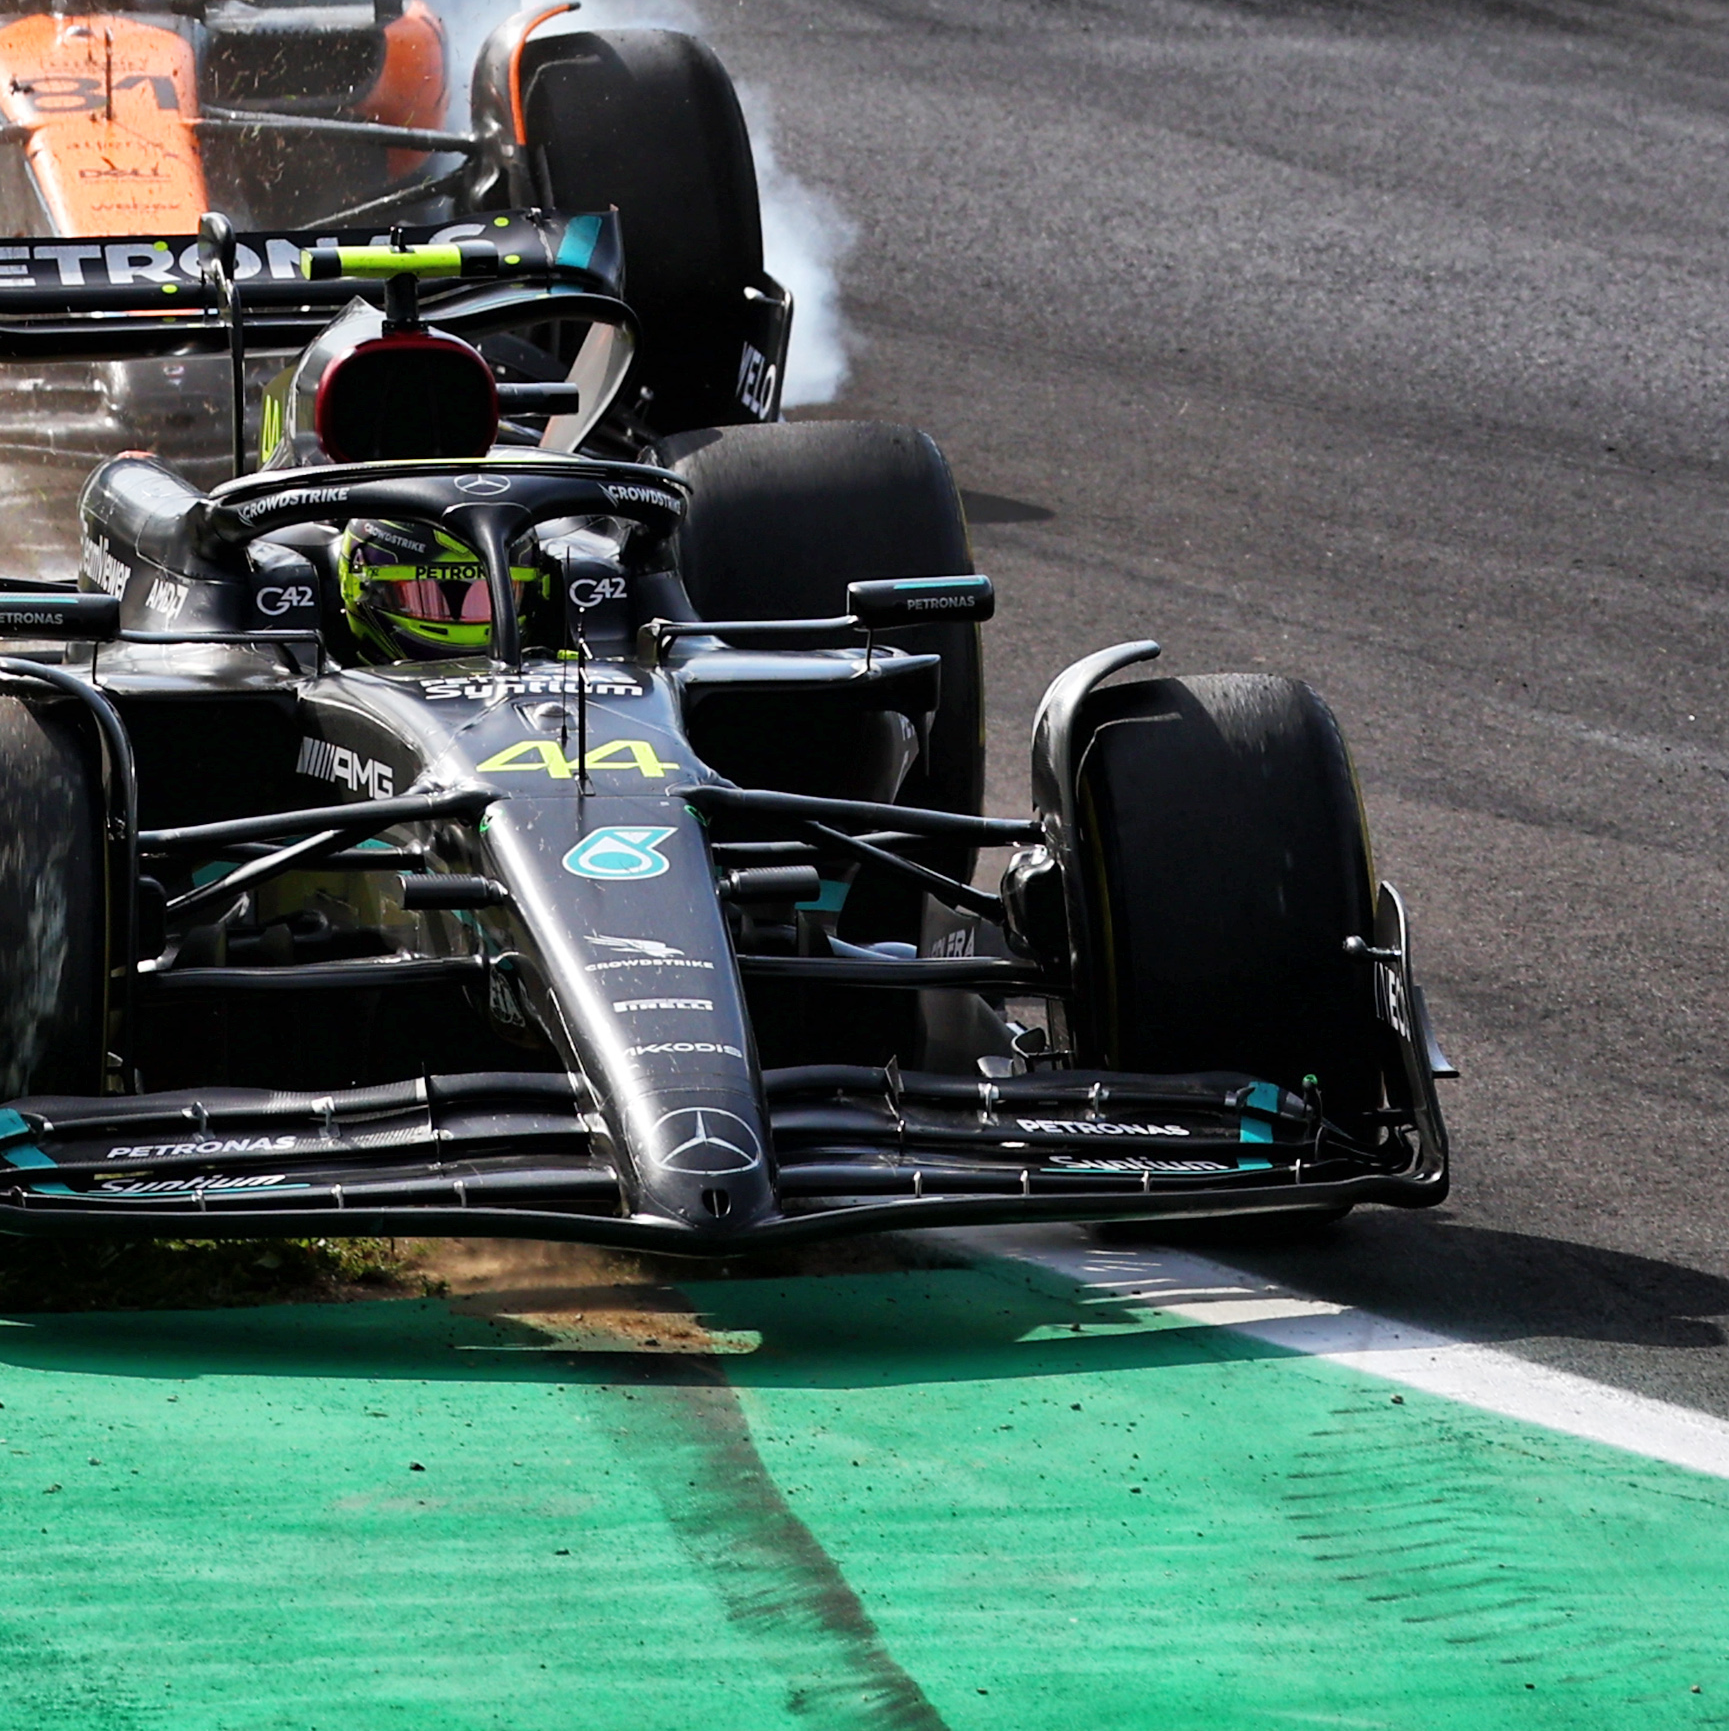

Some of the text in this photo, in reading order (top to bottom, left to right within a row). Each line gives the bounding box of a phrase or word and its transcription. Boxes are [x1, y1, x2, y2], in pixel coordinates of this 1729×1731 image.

[20, 75, 180, 113] 81
[242, 486, 351, 520] CROWDSTRIKE
[607, 484, 682, 516] CROWDSTRIKE
[363, 522, 427, 554] CROWDSTRIKE
[145, 577, 181, 616] AMD
[256, 585, 315, 616] G42
[569, 577, 628, 608] G42
[907, 595, 976, 611] PETRONAS
[333, 745, 394, 801] AMG
[476, 740, 680, 779] 44
[584, 958, 715, 972] CROWDSTRIKE
[613, 998, 714, 1013] PIRELLI
[1015, 1118, 1191, 1136] PETRONAS
[106, 1135, 297, 1159] PETRONAS
[1048, 1155, 1230, 1171] Syntium
[87, 1173, 286, 1194] Syntium
